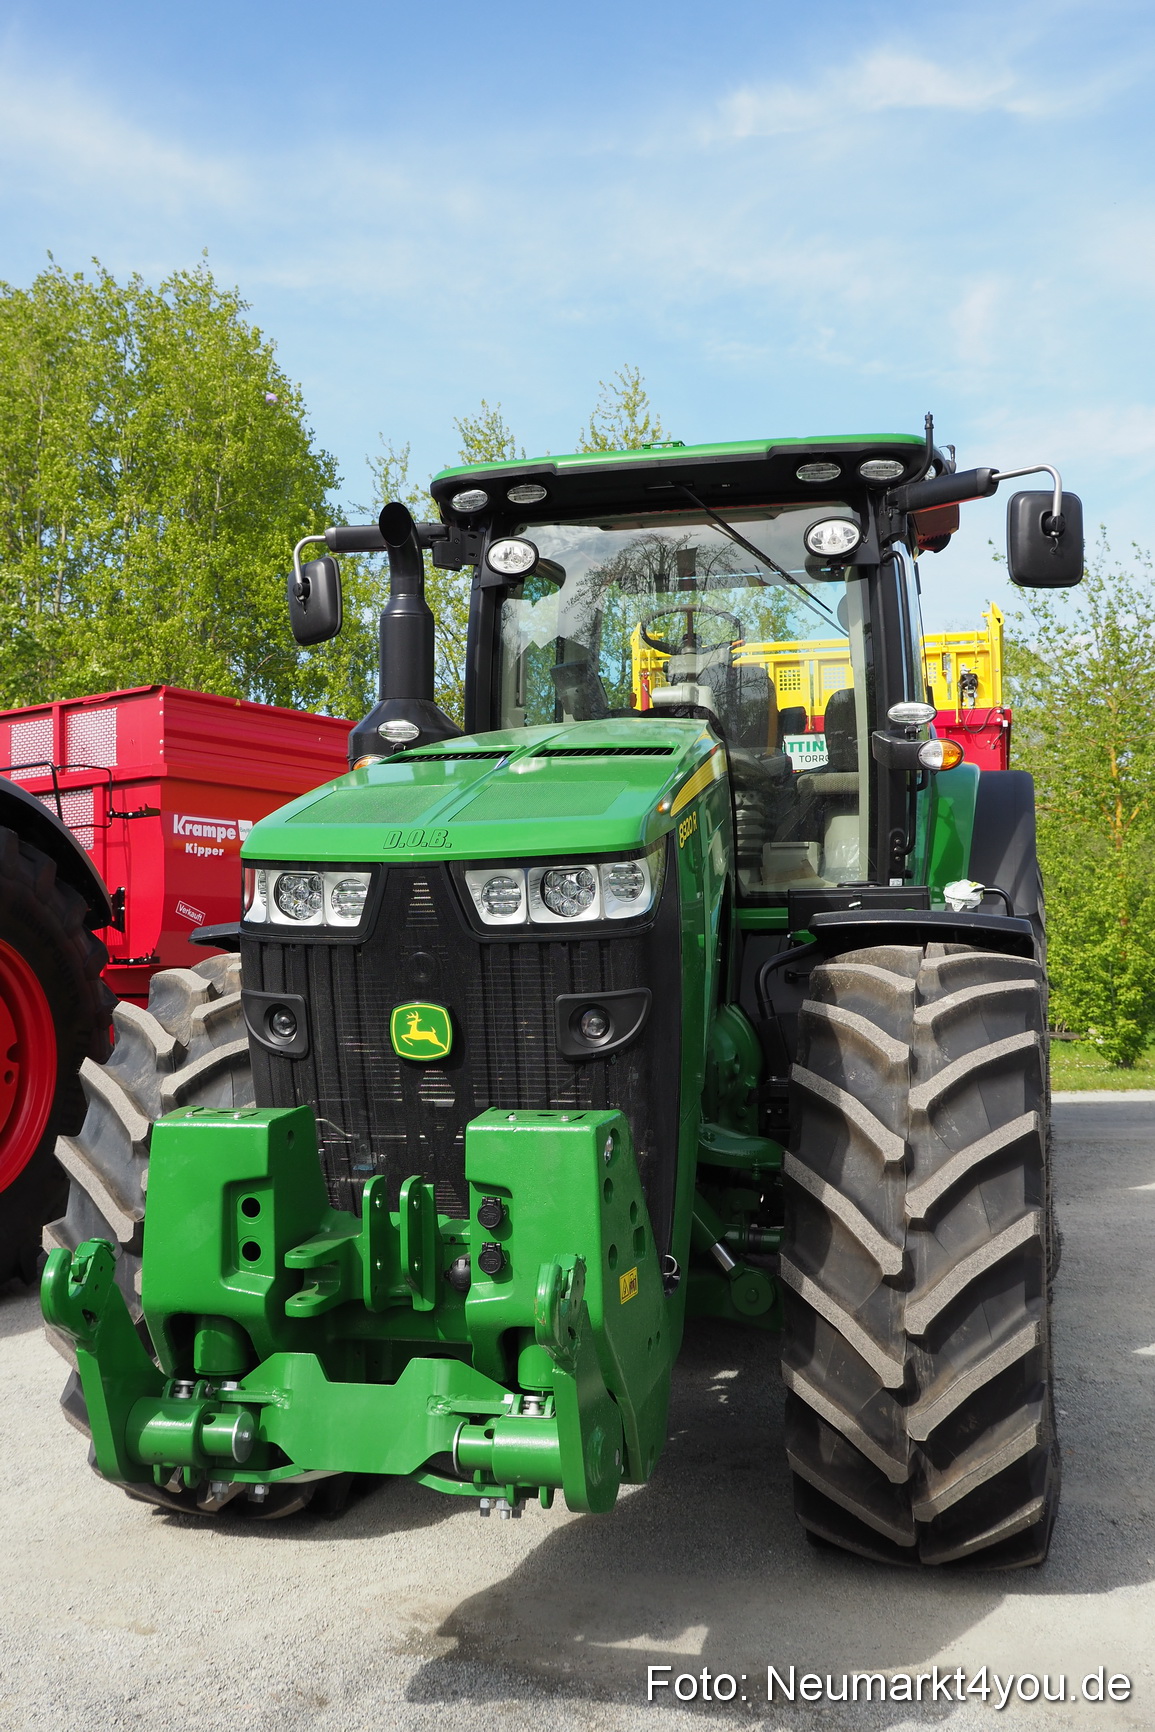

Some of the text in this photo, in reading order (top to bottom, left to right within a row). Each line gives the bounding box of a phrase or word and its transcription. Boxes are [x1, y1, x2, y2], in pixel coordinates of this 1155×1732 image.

[782, 740, 825, 753] TTIN
[173, 814, 237, 843] Krampe
[383, 829, 453, 849] D.O.B.
[185, 843, 225, 857] Kipper
[179, 904, 203, 922] Verkauft
